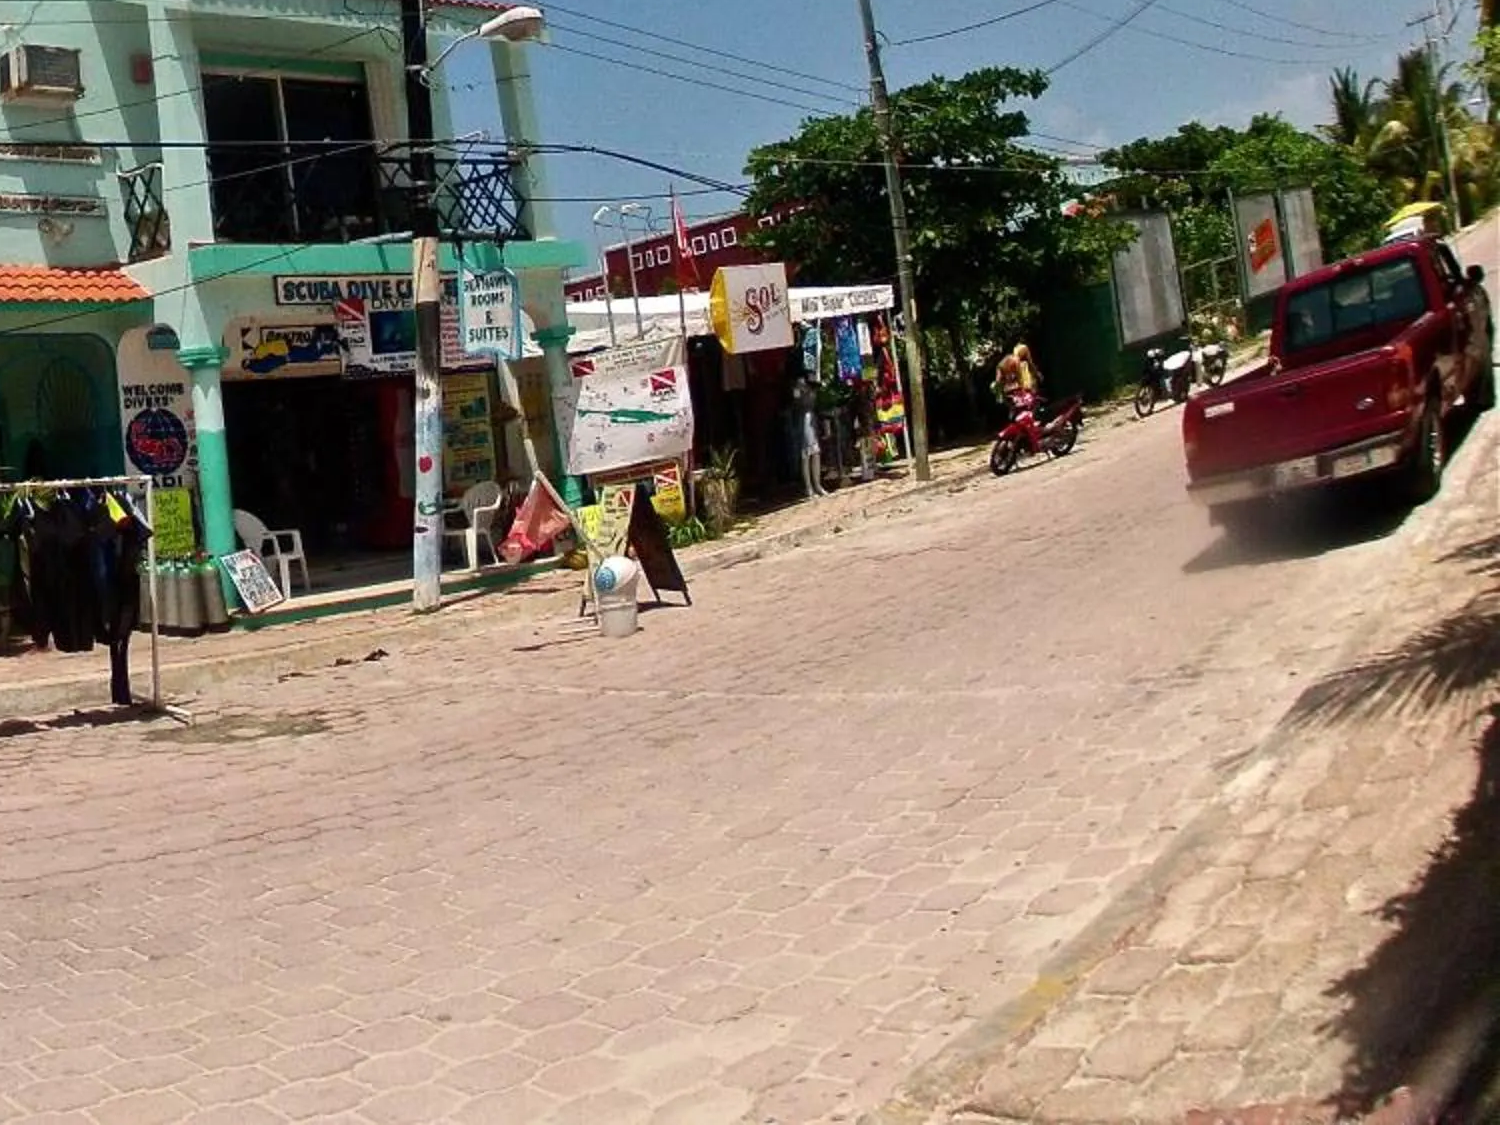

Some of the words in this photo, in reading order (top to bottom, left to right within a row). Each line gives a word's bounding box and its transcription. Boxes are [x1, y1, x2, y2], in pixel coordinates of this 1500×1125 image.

[283, 280, 343, 301] SCUBA
[471, 291, 505, 307] ROOMS
[468, 326, 508, 342] SUITES
[123, 383, 185, 396] WELCOME
